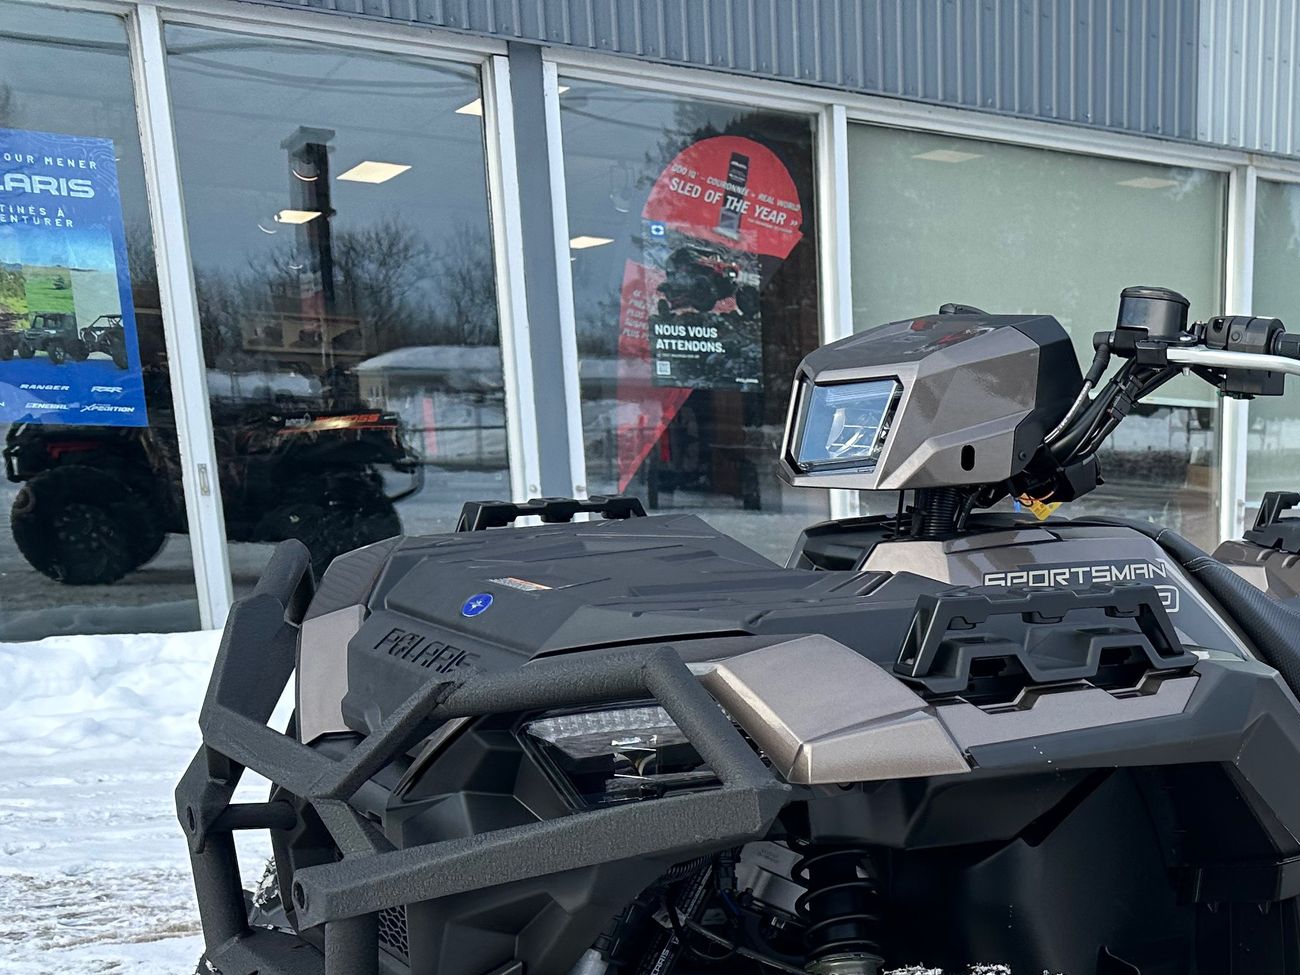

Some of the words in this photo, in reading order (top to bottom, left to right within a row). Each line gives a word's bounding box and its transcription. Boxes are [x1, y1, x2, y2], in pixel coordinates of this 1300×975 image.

[44, 156, 97, 169] MENER
[0, 173, 95, 198] ARIS
[669, 178, 702, 198] SLED
[704, 189, 723, 204] OF
[725, 195, 751, 214] THE
[754, 205, 788, 225] YEAR
[655, 324, 687, 337] NOUS
[687, 325, 718, 338] VOUS
[655, 338, 726, 353] ATTENDONS.
[20, 383, 70, 391] RANGER
[984, 563, 1168, 587] SPORTSMAN
